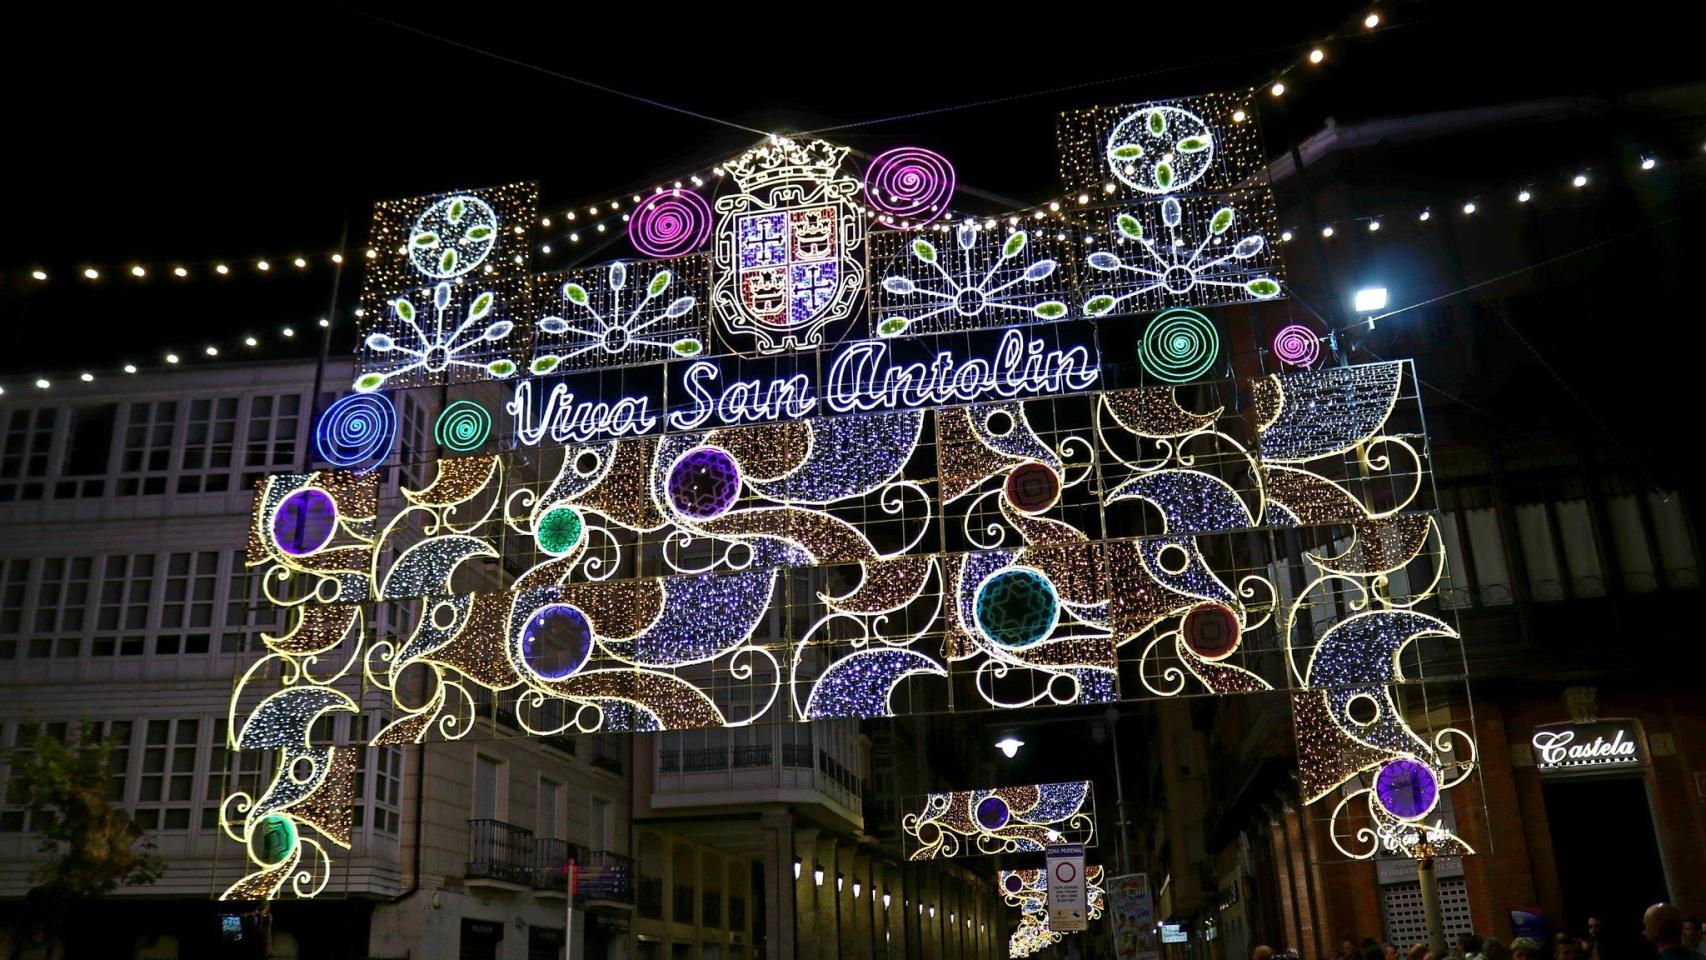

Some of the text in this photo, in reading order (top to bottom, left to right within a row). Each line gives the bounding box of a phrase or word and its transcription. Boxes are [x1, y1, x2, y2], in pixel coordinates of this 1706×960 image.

[506, 381, 656, 445] Viva
[670, 361, 817, 430] San
[1532, 729, 1636, 764] Castela
